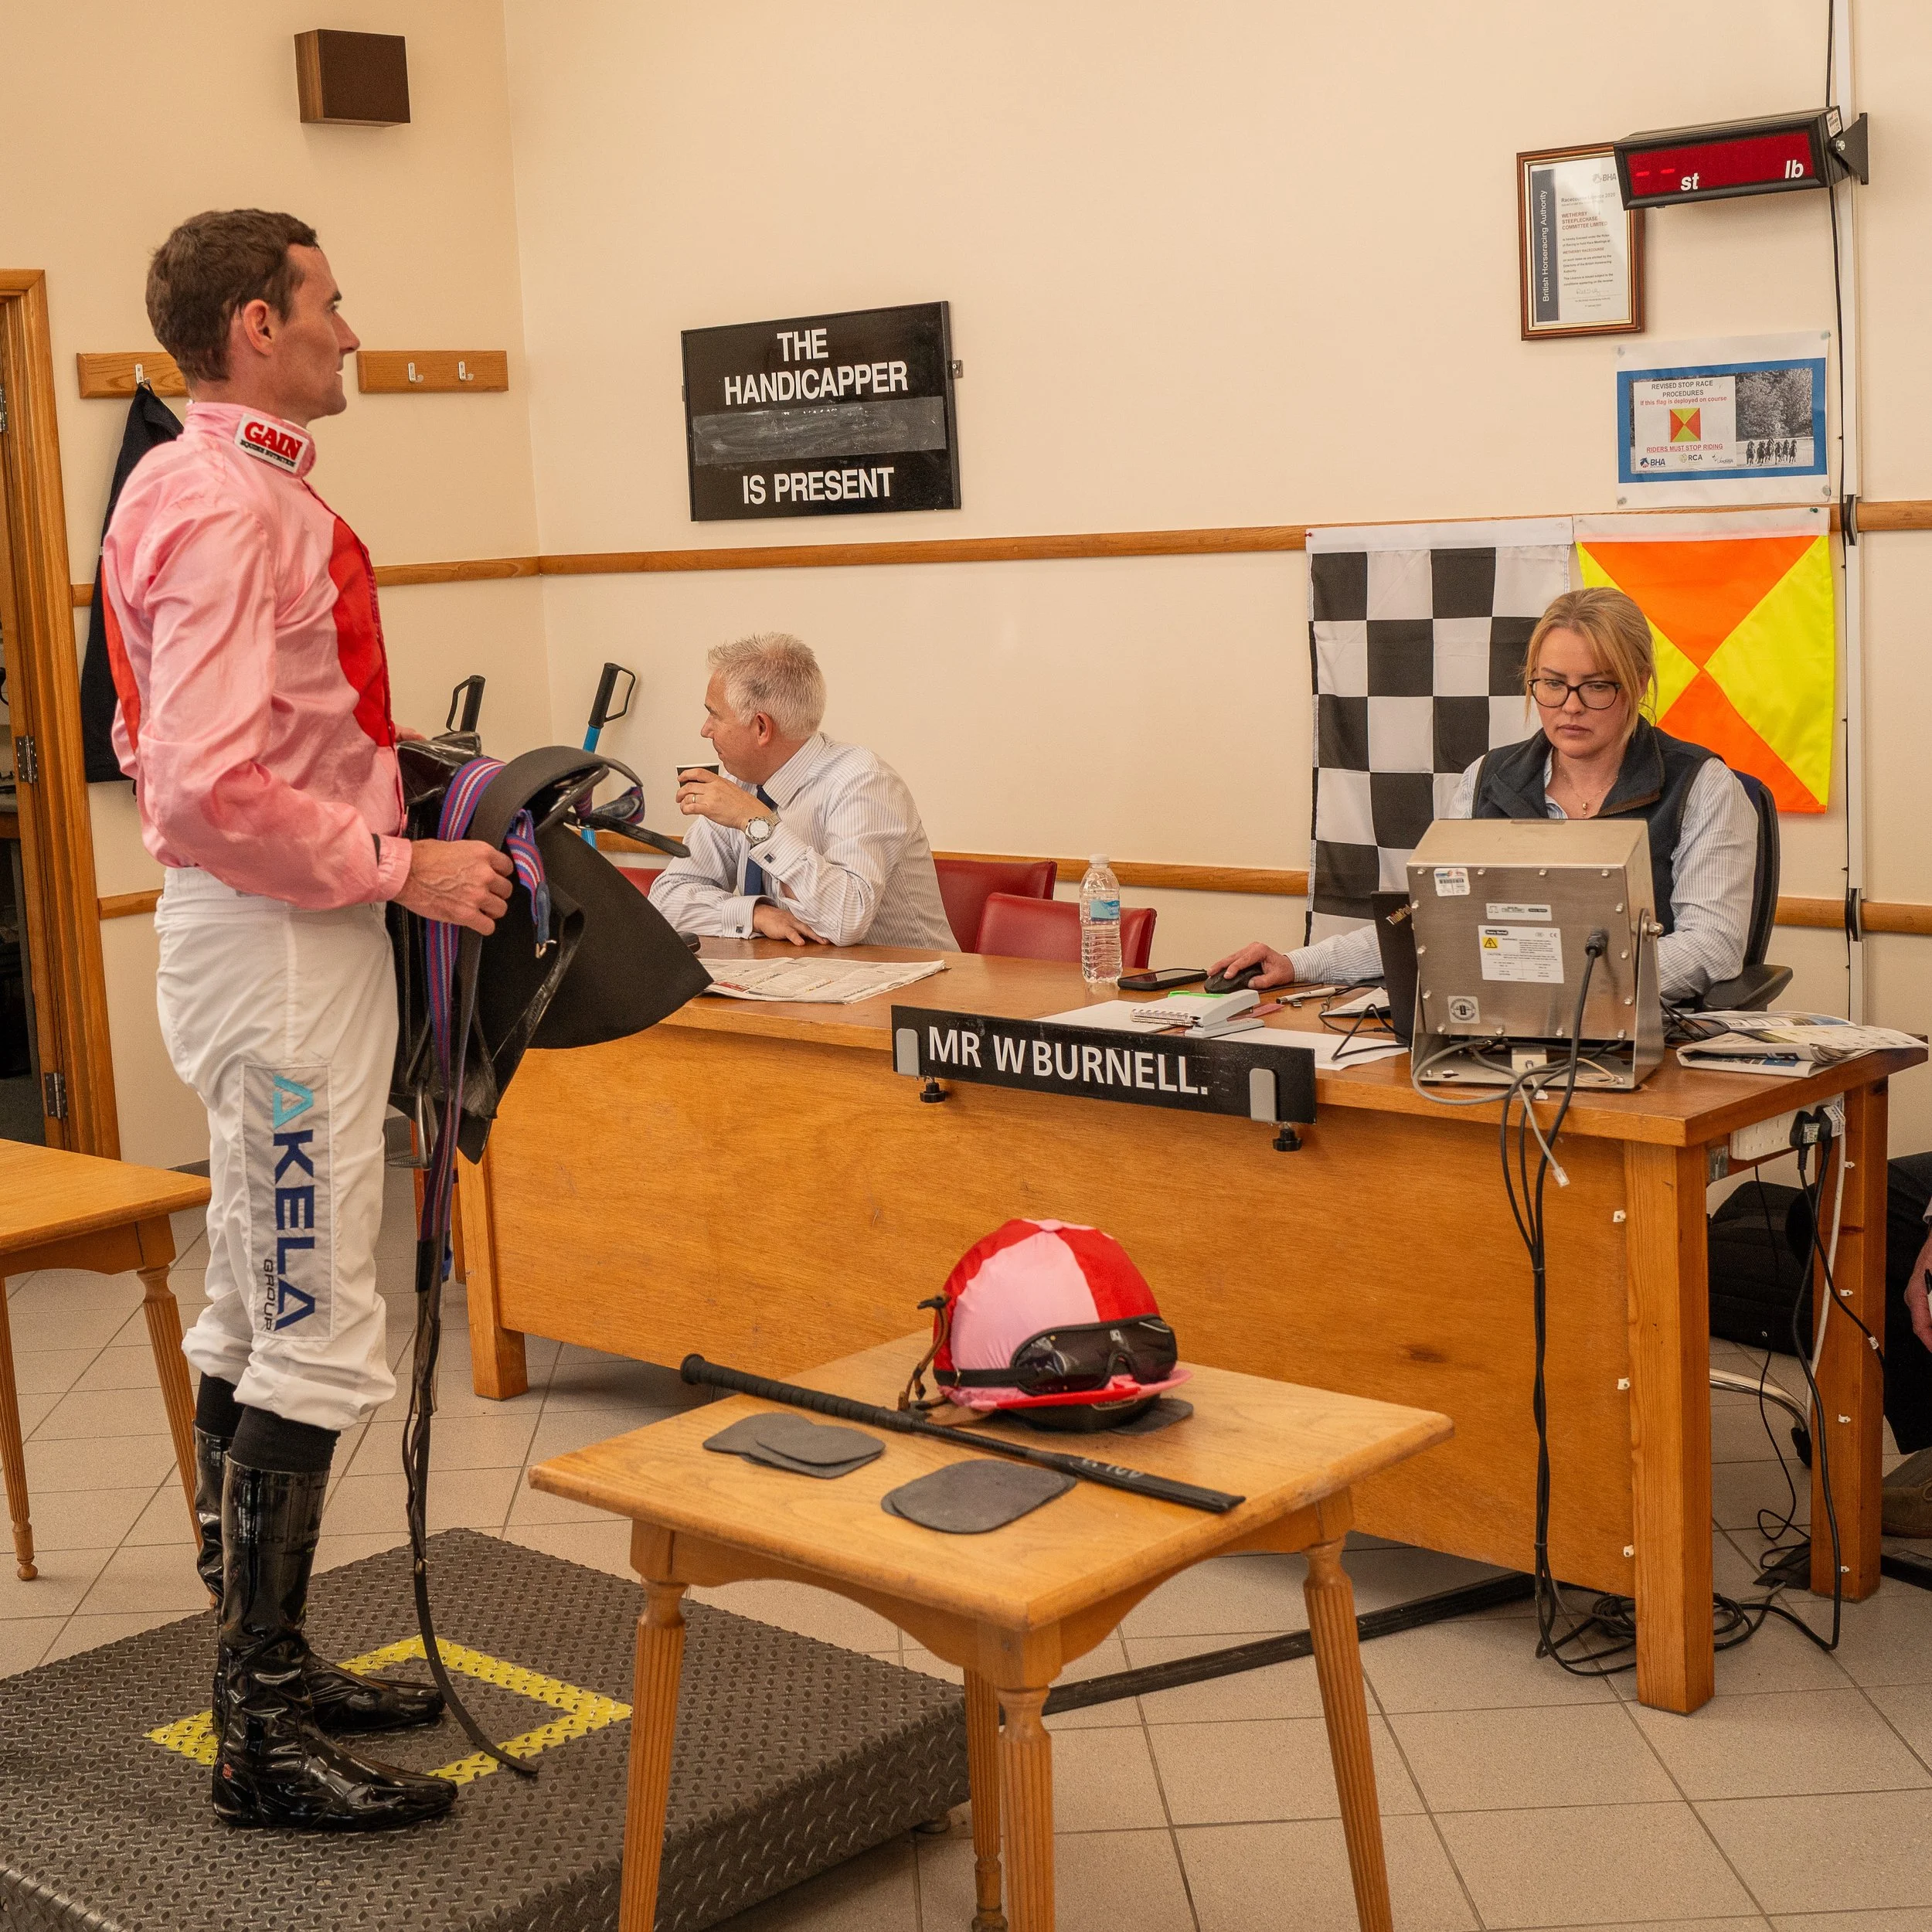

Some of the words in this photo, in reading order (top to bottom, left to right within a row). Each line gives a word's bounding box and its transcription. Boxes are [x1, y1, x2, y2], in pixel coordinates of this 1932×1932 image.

[1602, 173, 1617, 182] BHA
[1680, 173, 1699, 191] st
[1784, 159, 1804, 179] lb
[777, 328, 828, 362] THE
[724, 361, 908, 405] HANDICAPPER
[244, 421, 304, 461] GAIN
[743, 474, 766, 505] IS
[774, 467, 894, 502] PRESENT
[929, 1026, 981, 1067] MR
[273, 1074, 315, 1332] AKELA
[264, 1259, 276, 1330] GROUP
